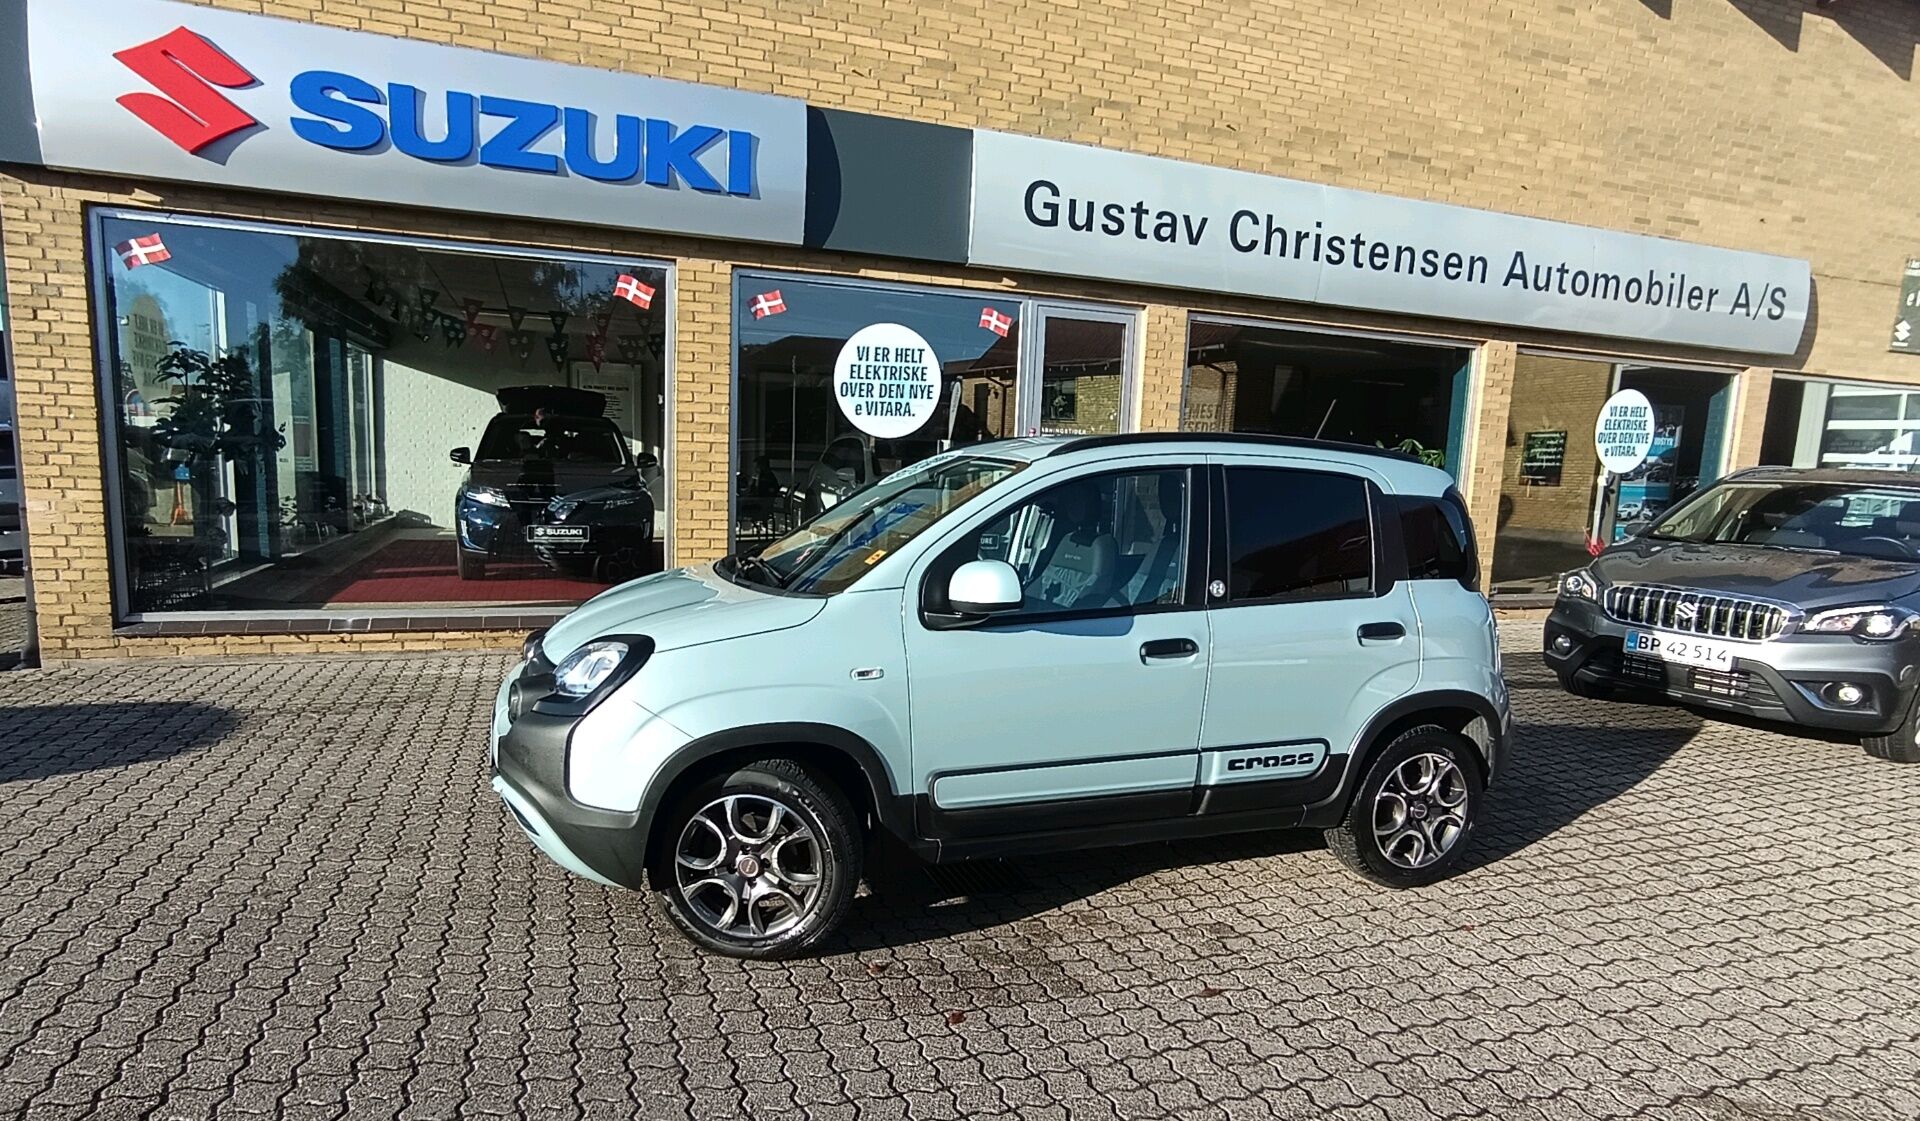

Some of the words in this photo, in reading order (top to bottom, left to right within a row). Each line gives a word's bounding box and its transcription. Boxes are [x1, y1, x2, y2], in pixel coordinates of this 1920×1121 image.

[290, 70, 752, 197] SUZUKI
[1024, 179, 1209, 246] Gustav
[1229, 209, 1489, 284] Christensen
[1502, 250, 1720, 313] Automobiler
[1729, 282, 1788, 321] A/S
[856, 346, 870, 361] VI
[874, 347, 890, 362] ER
[894, 347, 925, 364] HELT
[849, 364, 928, 382] ELEKTRISKE
[840, 382, 874, 398] OVER
[878, 383, 905, 399] DEN
[909, 384, 934, 399] NYE
[855, 403, 863, 416] e
[865, 401, 916, 417] VITARA.
[1609, 405, 1618, 417] VI
[1618, 406, 1629, 418] ER
[1629, 406, 1648, 418] HELT
[1604, 419, 1648, 431] ELEKTRISKE
[1597, 432, 1618, 444] OVER
[1618, 432, 1634, 444] DEN
[1634, 432, 1650, 444] NYE
[546, 528, 583, 536] SUZUKI
[1637, 636, 1661, 651] BP
[1666, 641, 1688, 657] 42
[1692, 645, 1727, 663] 514
[1227, 752, 1314, 771] cross
